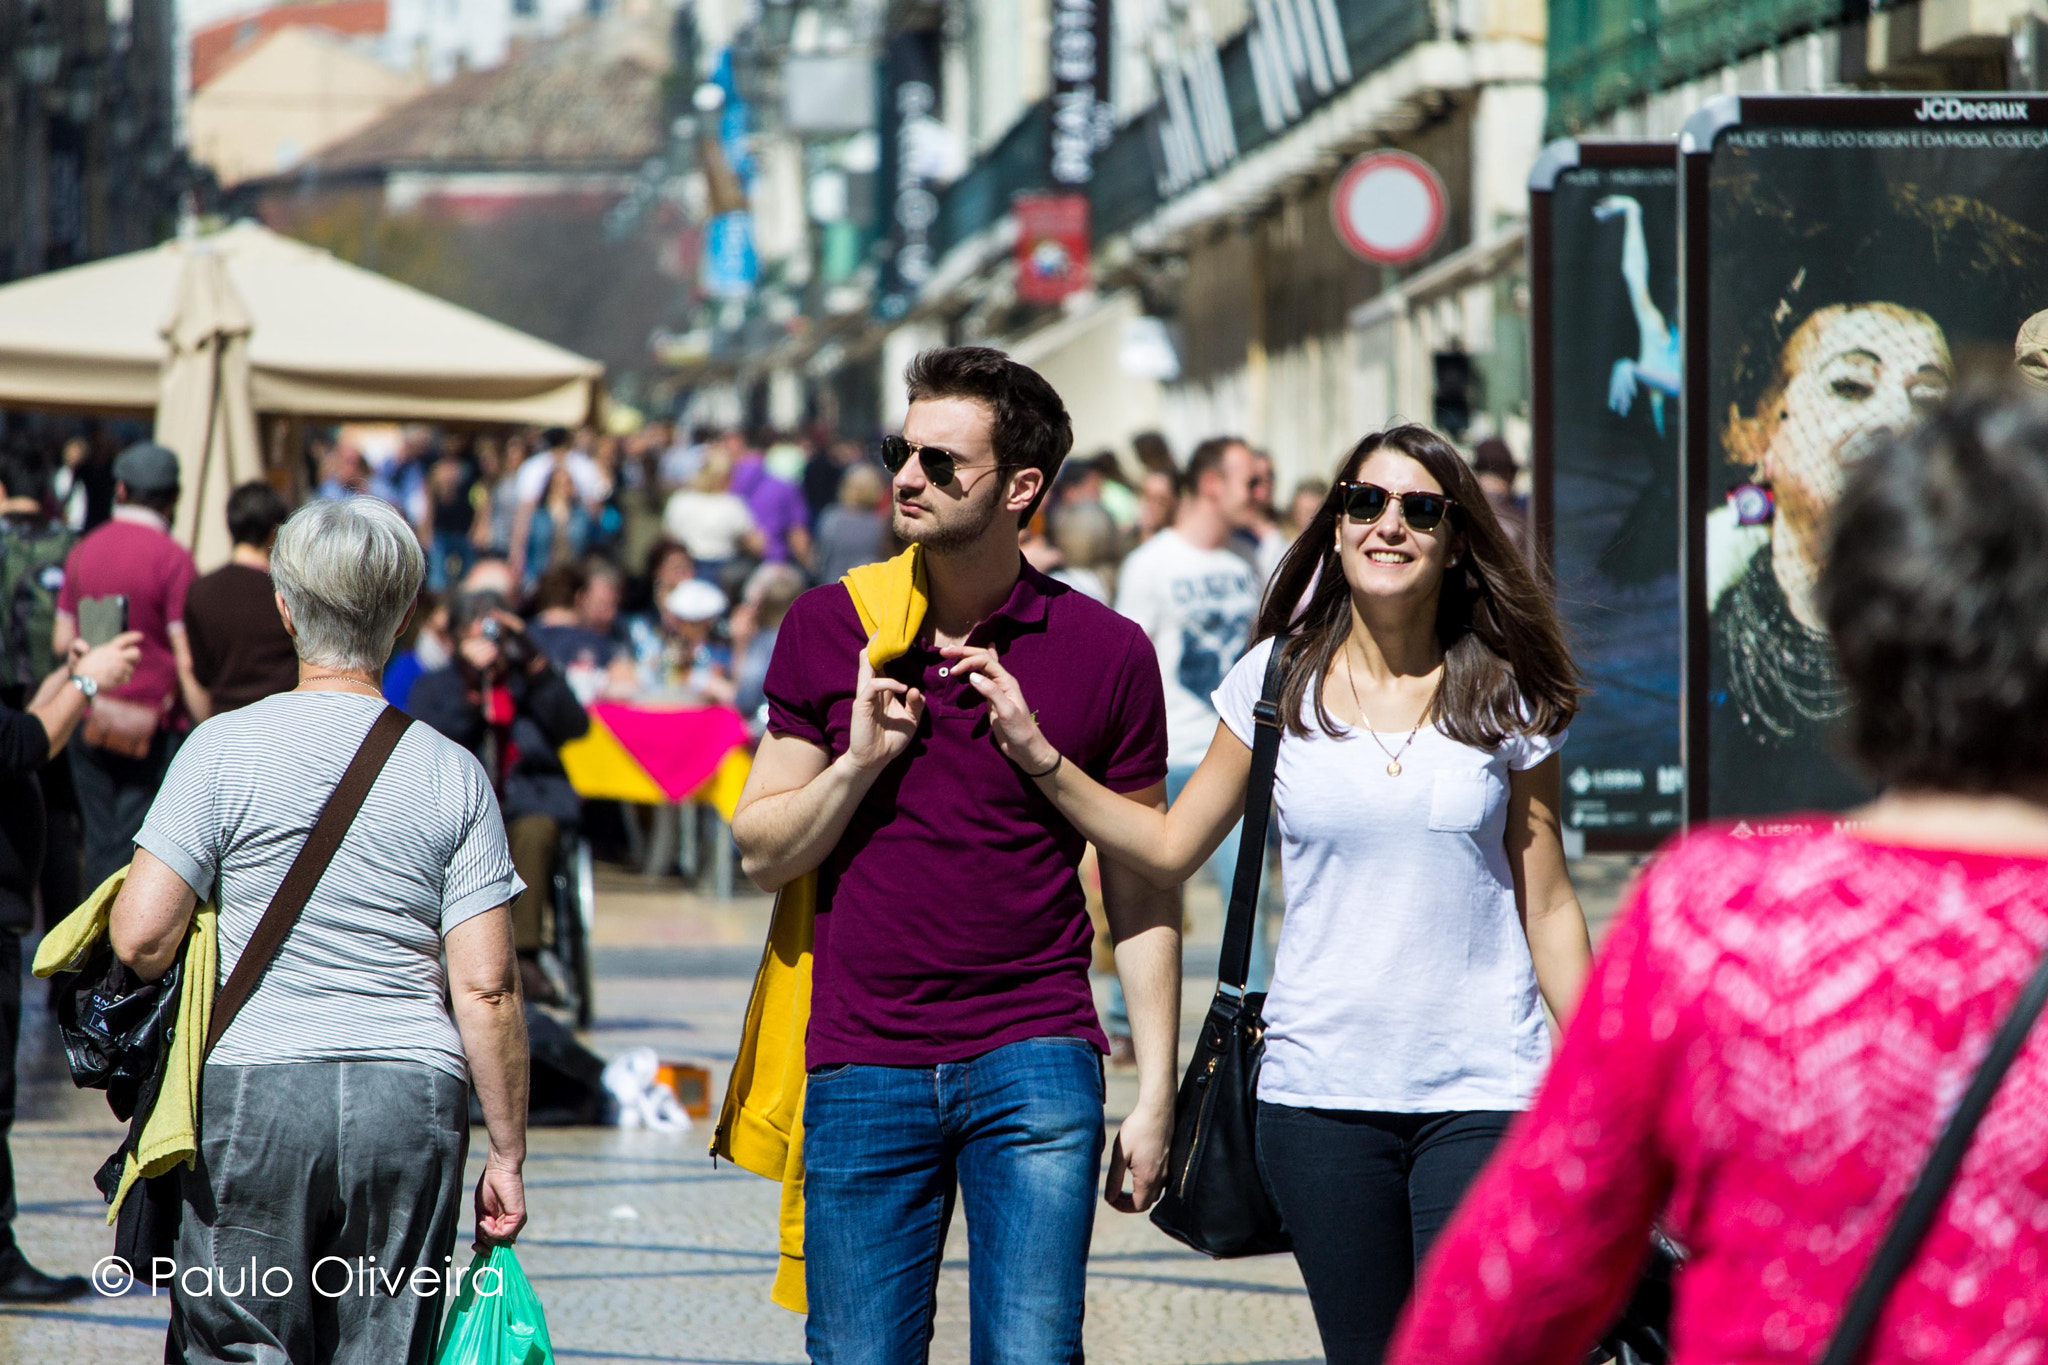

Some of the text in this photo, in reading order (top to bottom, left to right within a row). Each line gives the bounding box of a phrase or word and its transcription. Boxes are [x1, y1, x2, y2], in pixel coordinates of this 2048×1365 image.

[1914, 98, 2029, 121] JCDecaux
[1726, 131, 1767, 148] MUDE
[1781, 131, 1830, 148] MUSEU
[1831, 131, 1856, 148] DO
[1857, 131, 1909, 148] DESIGN
[1910, 131, 1920, 148] E
[1921, 131, 1944, 148] DA
[1757, 824, 1813, 837] LISBOA
